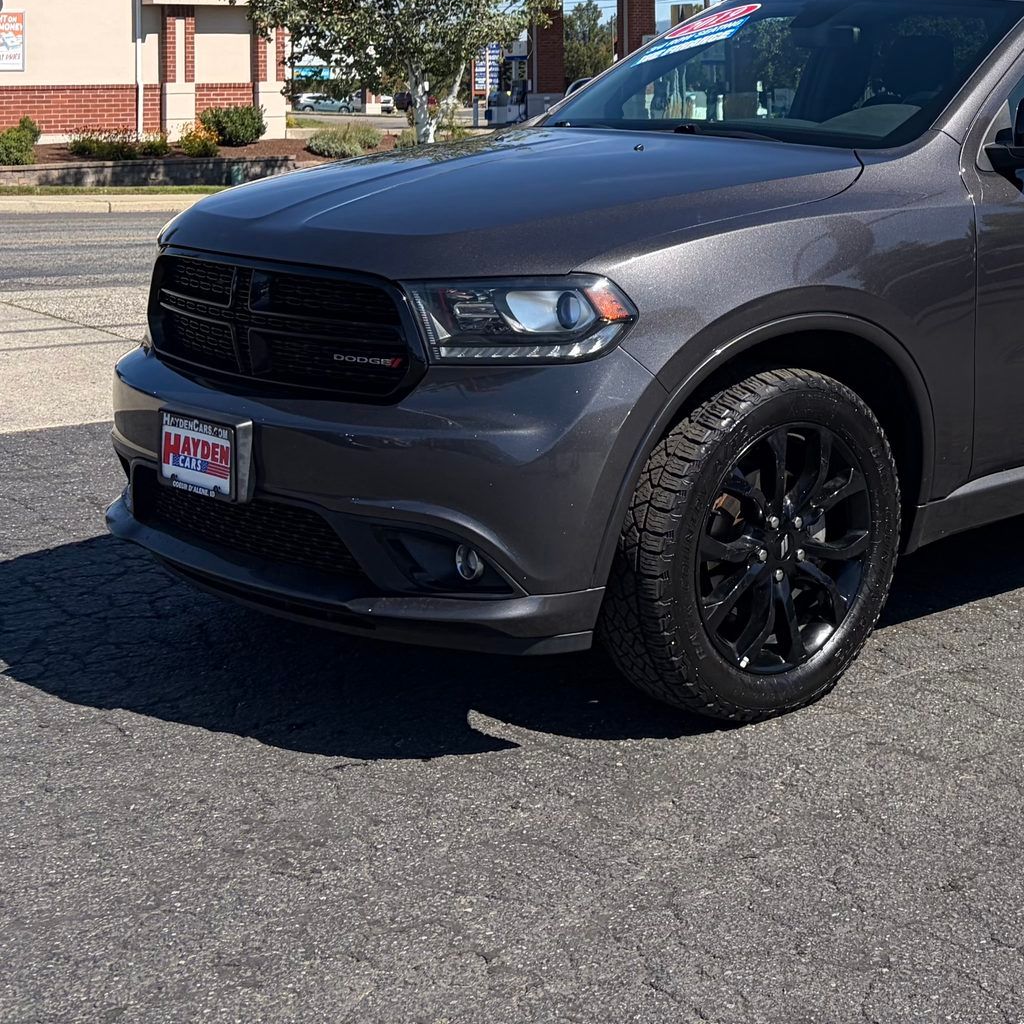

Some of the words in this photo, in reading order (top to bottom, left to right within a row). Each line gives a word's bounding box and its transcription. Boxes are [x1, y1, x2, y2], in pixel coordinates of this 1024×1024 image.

[333, 353, 392, 366] DODGE
[163, 431, 229, 466] HAYDEN
[179, 455, 202, 471] CARS
